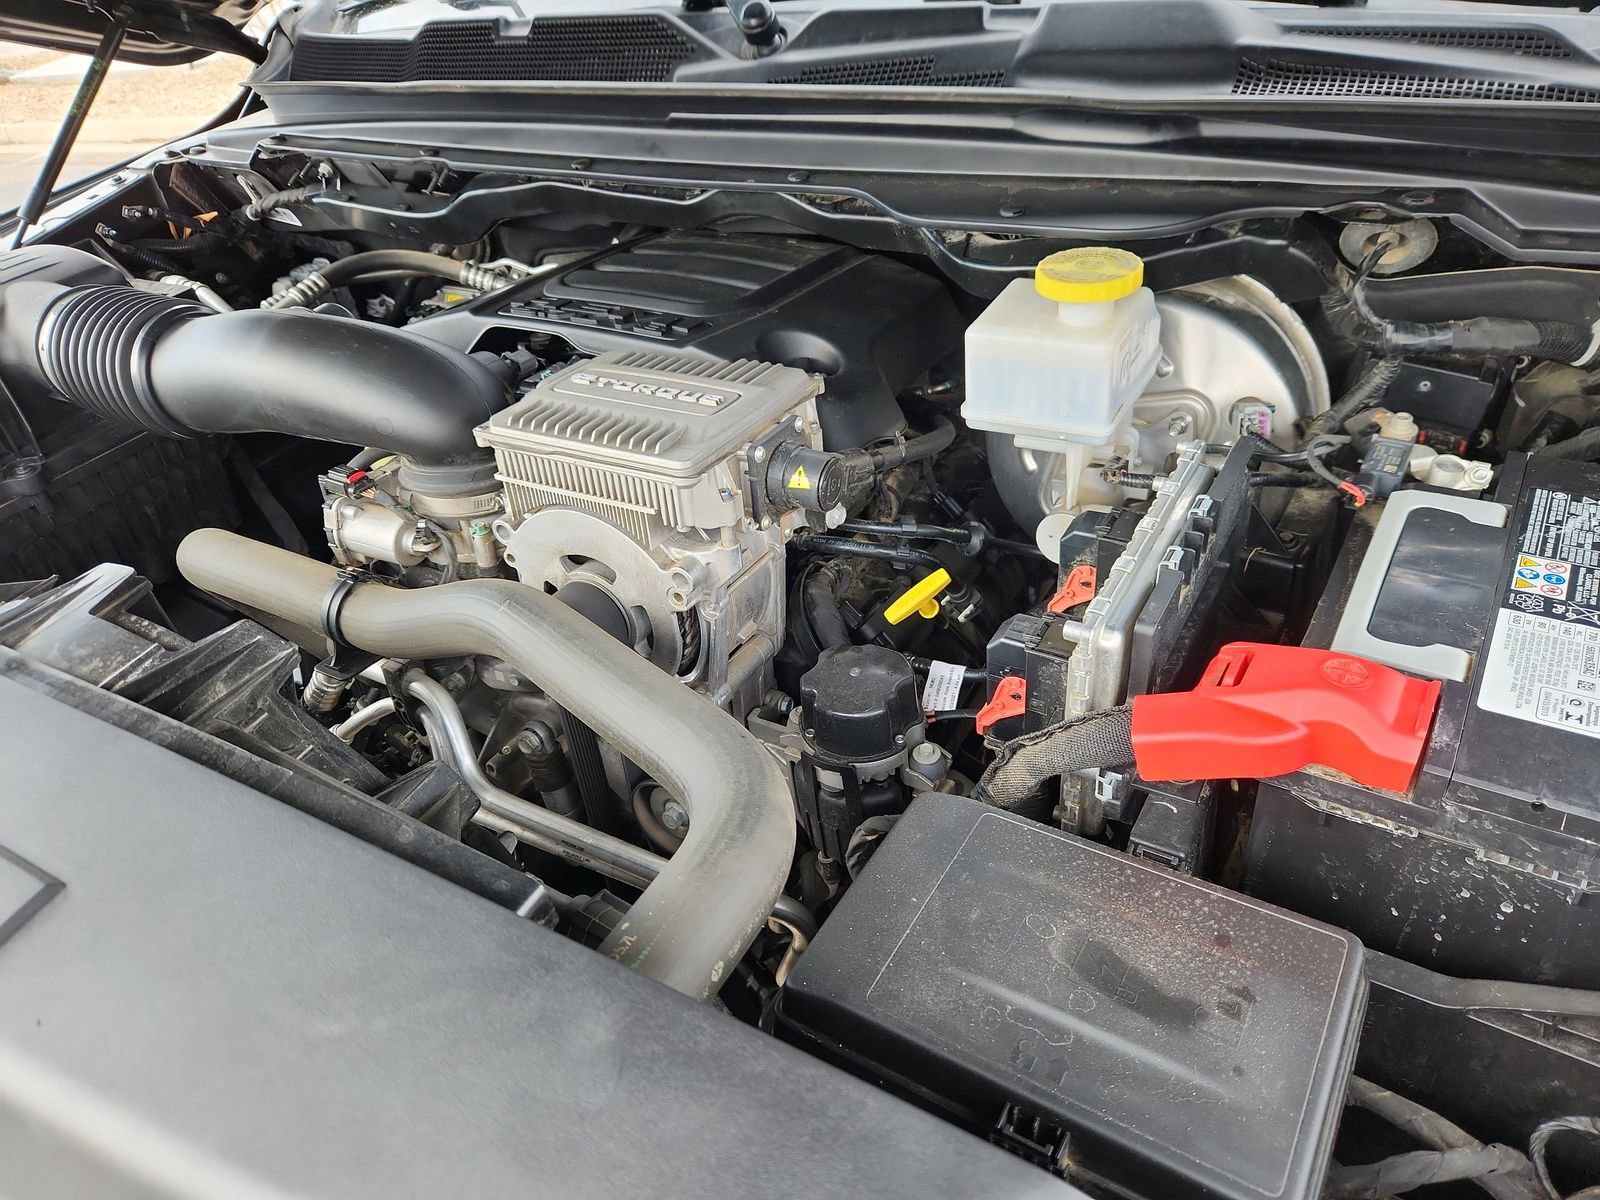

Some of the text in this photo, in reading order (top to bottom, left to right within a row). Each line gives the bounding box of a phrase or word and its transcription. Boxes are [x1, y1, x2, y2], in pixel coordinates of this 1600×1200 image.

[1552, 604, 1565, 614] Pb
[1511, 614, 1521, 624] 630
[1587, 631, 1598, 642] 730
